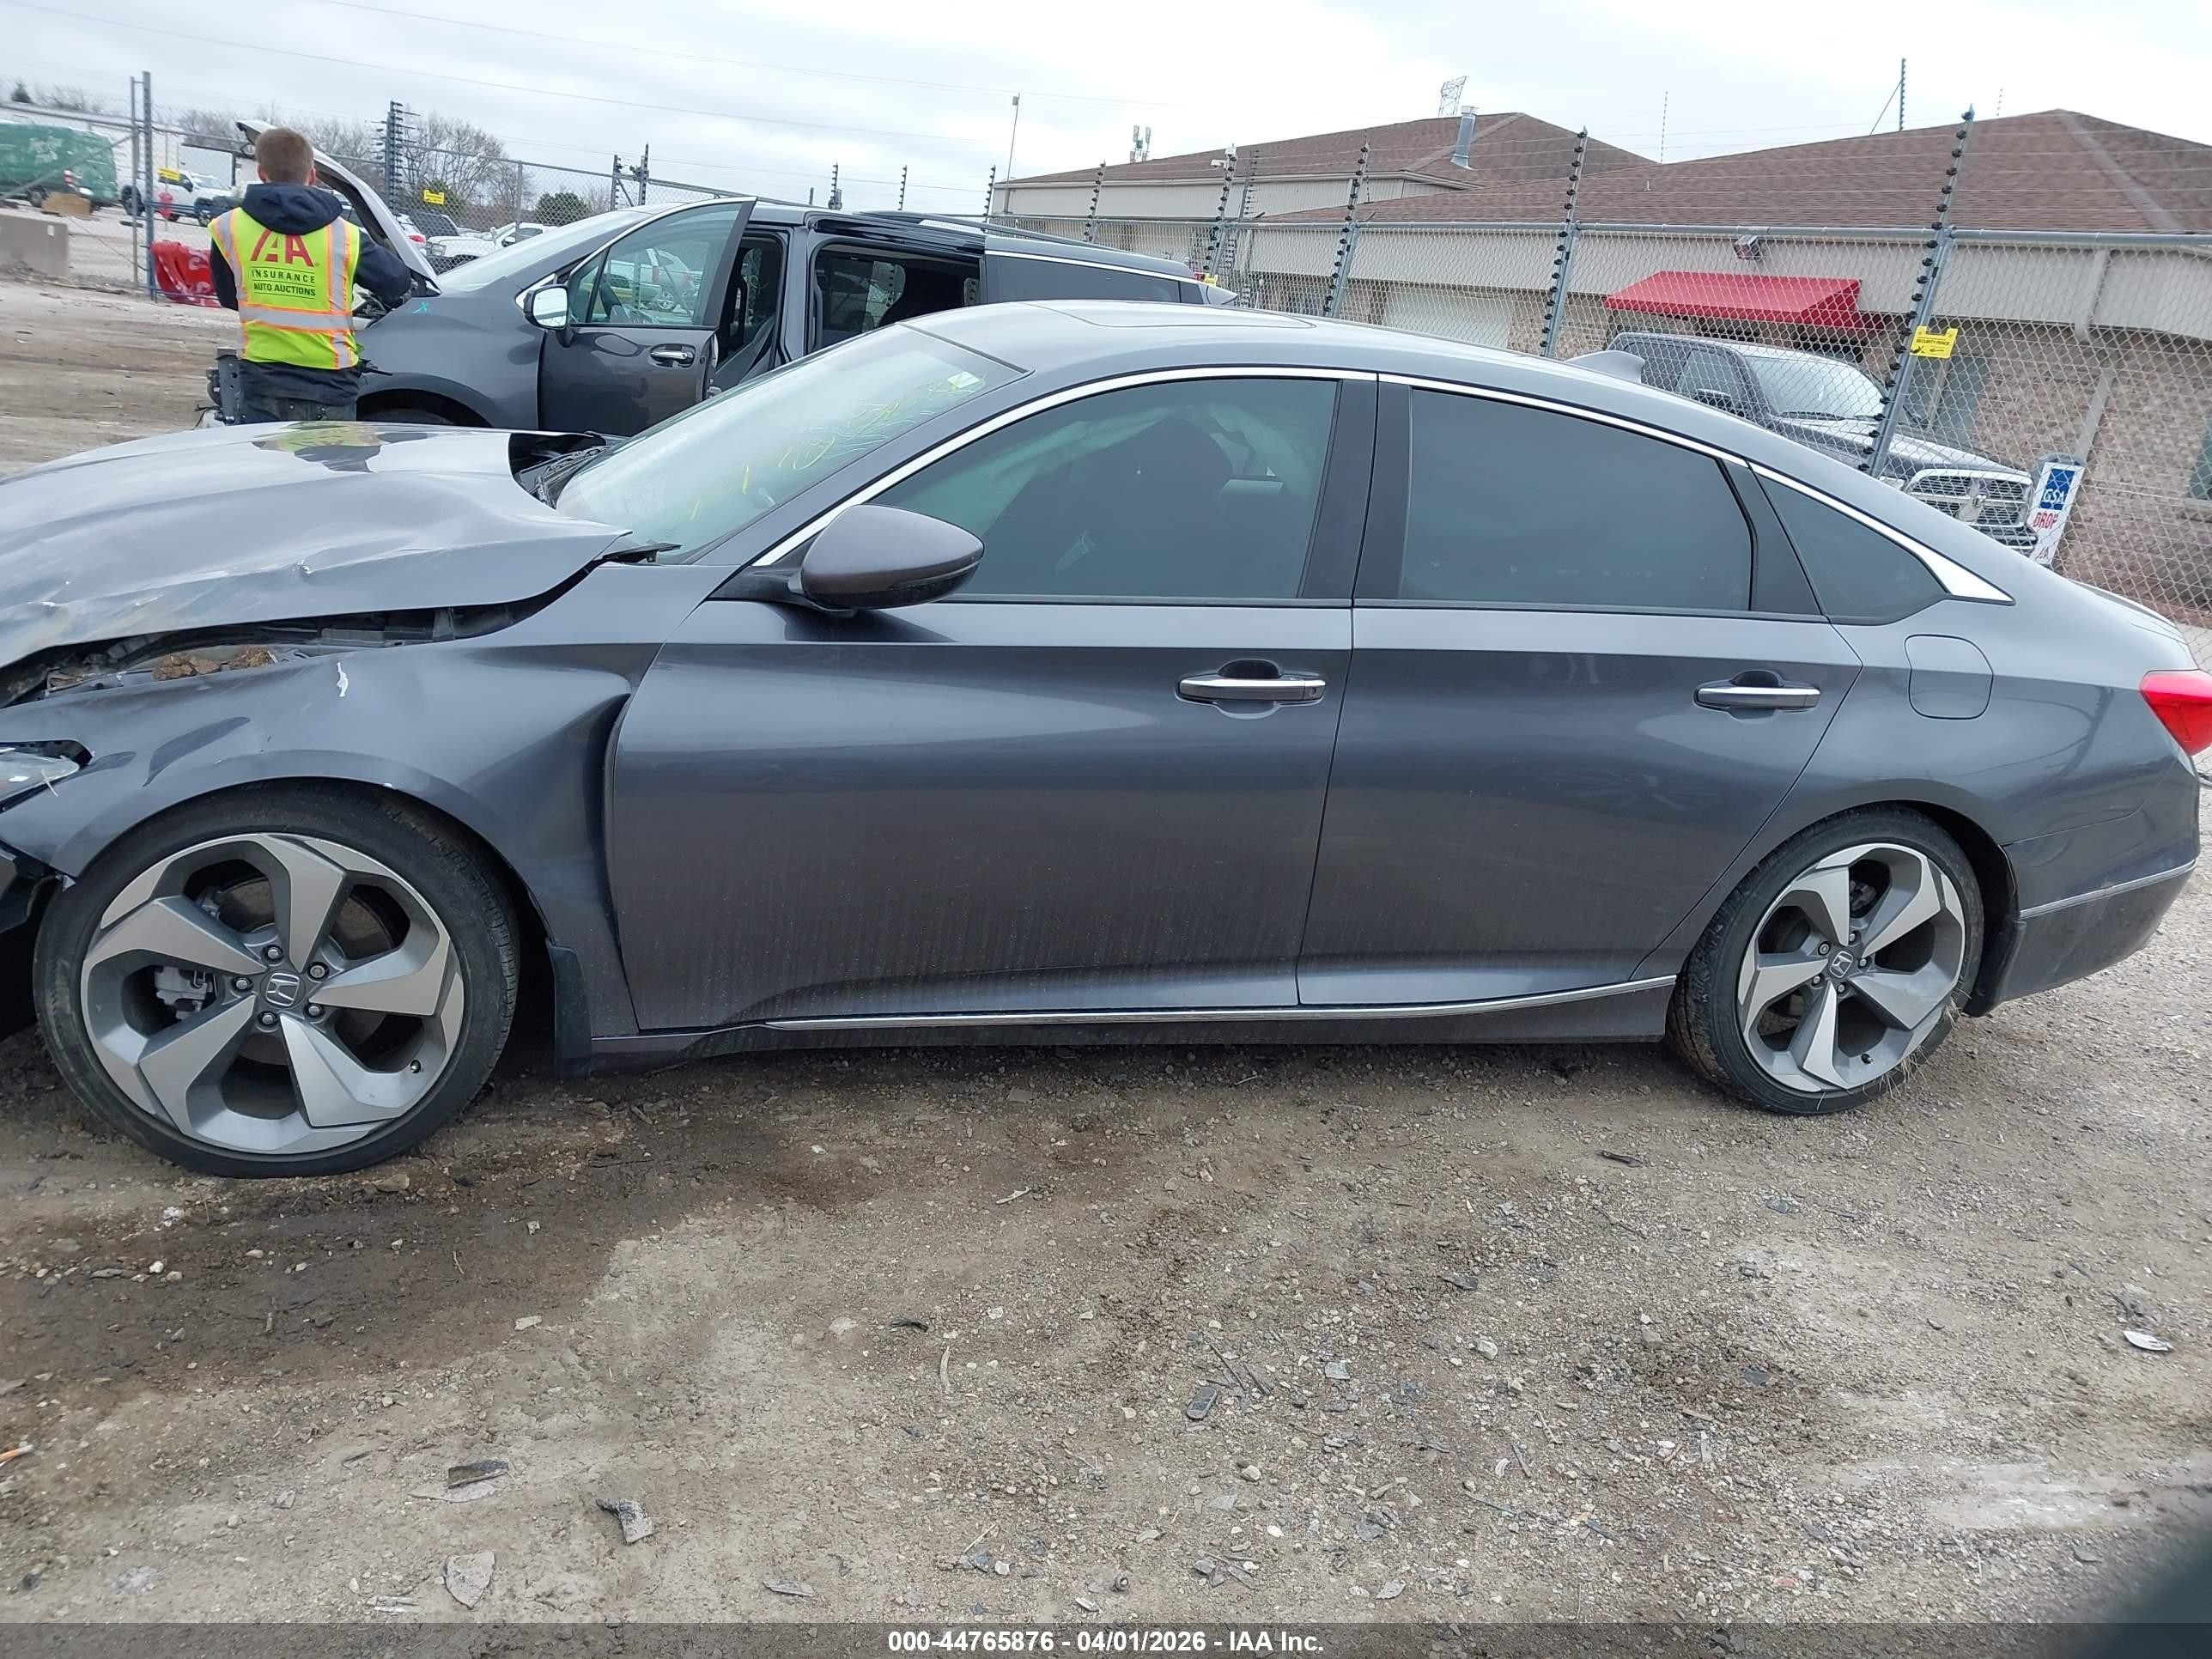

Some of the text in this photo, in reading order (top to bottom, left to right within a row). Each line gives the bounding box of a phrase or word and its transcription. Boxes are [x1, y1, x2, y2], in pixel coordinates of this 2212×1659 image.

[251, 269, 316, 284] INSURANCE
[253, 283, 316, 296] AUTO AUCTIONS
[2043, 488, 2065, 504] GSA
